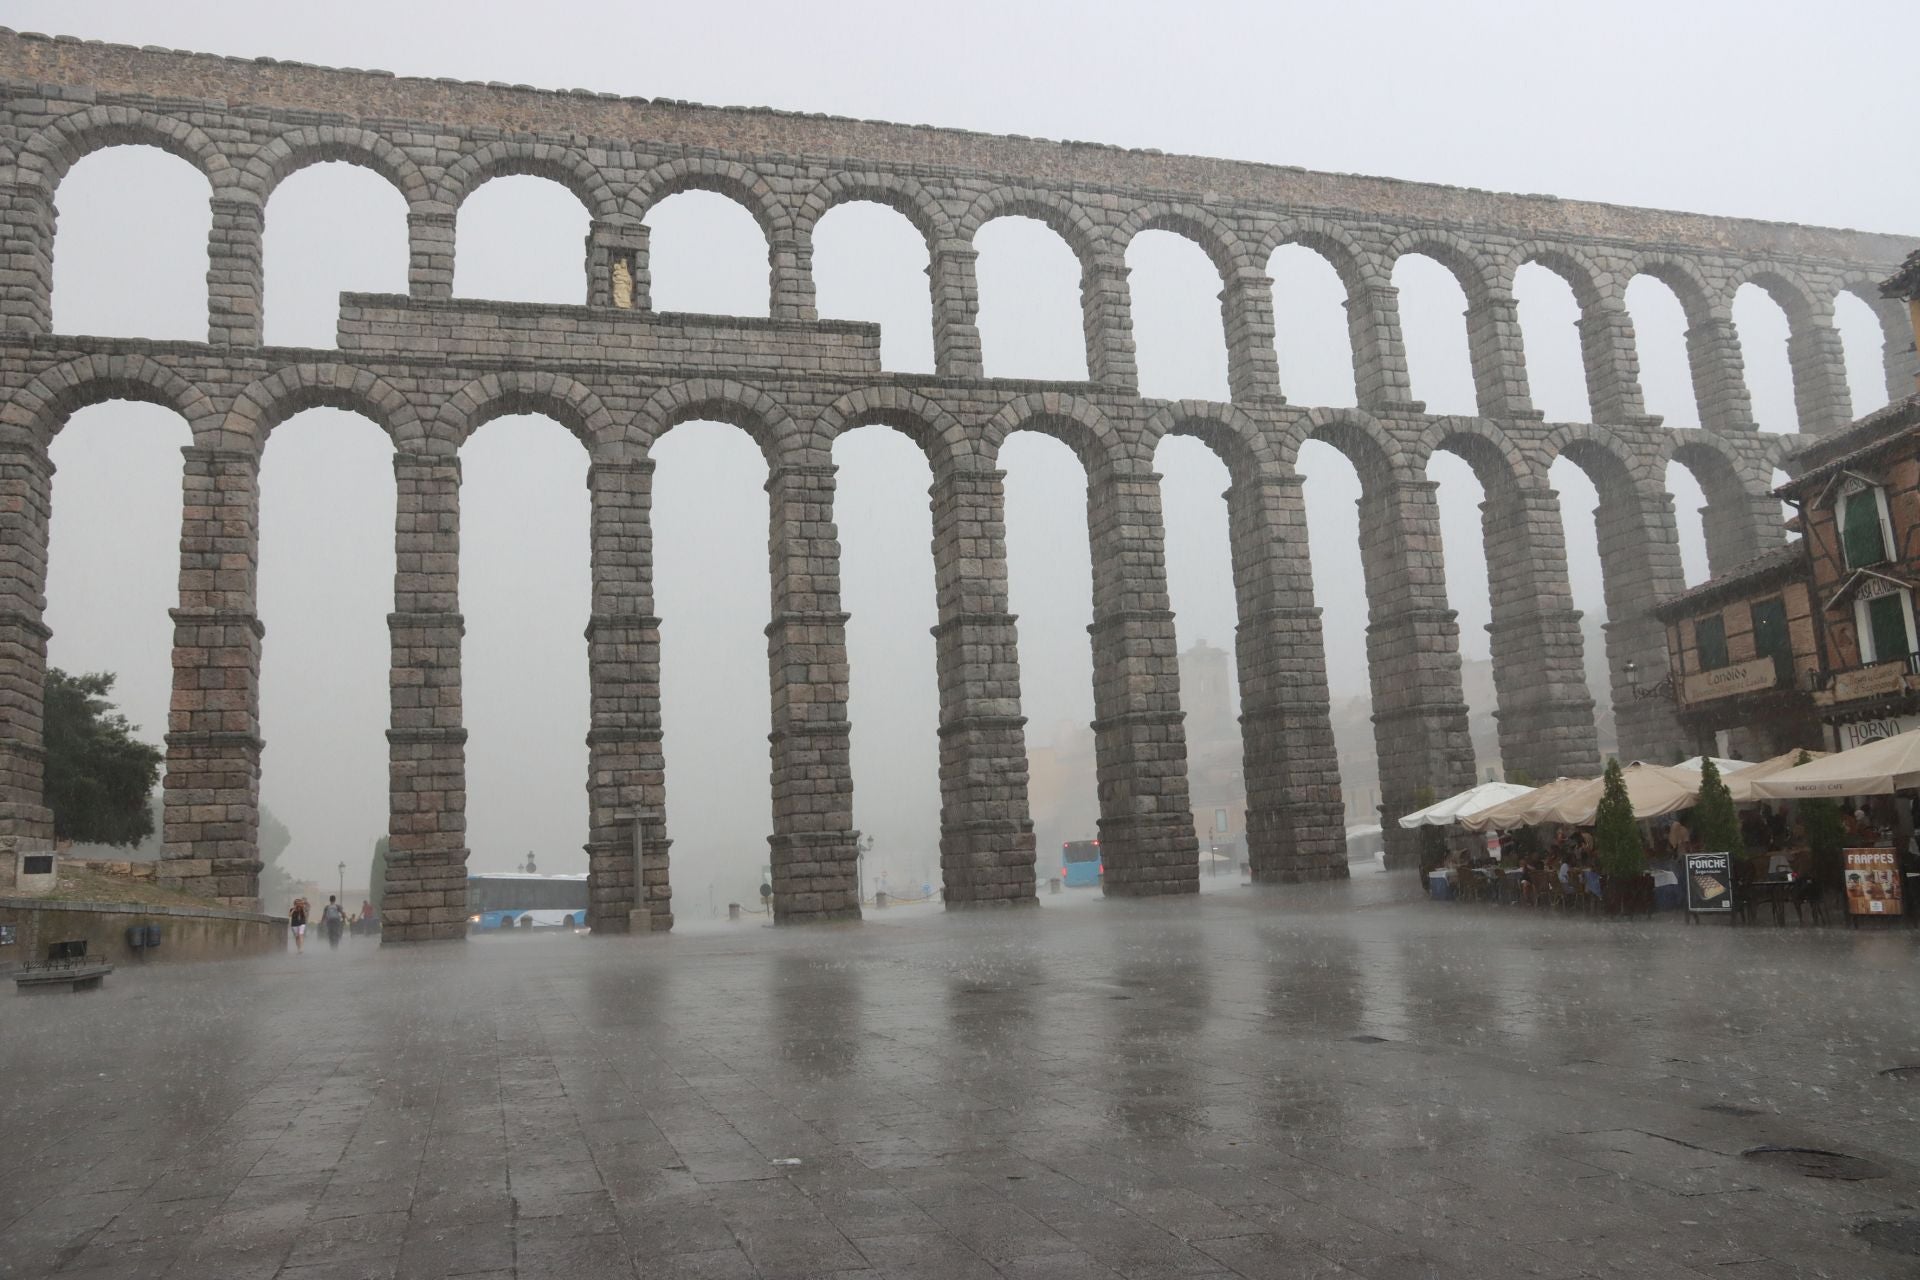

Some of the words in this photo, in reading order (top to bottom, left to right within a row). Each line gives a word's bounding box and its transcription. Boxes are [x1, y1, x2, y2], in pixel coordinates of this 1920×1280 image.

[1848, 720, 1901, 749] HORNO
[1689, 859, 1727, 868] PONCHE
[1847, 853, 1894, 864] FRAPPES
